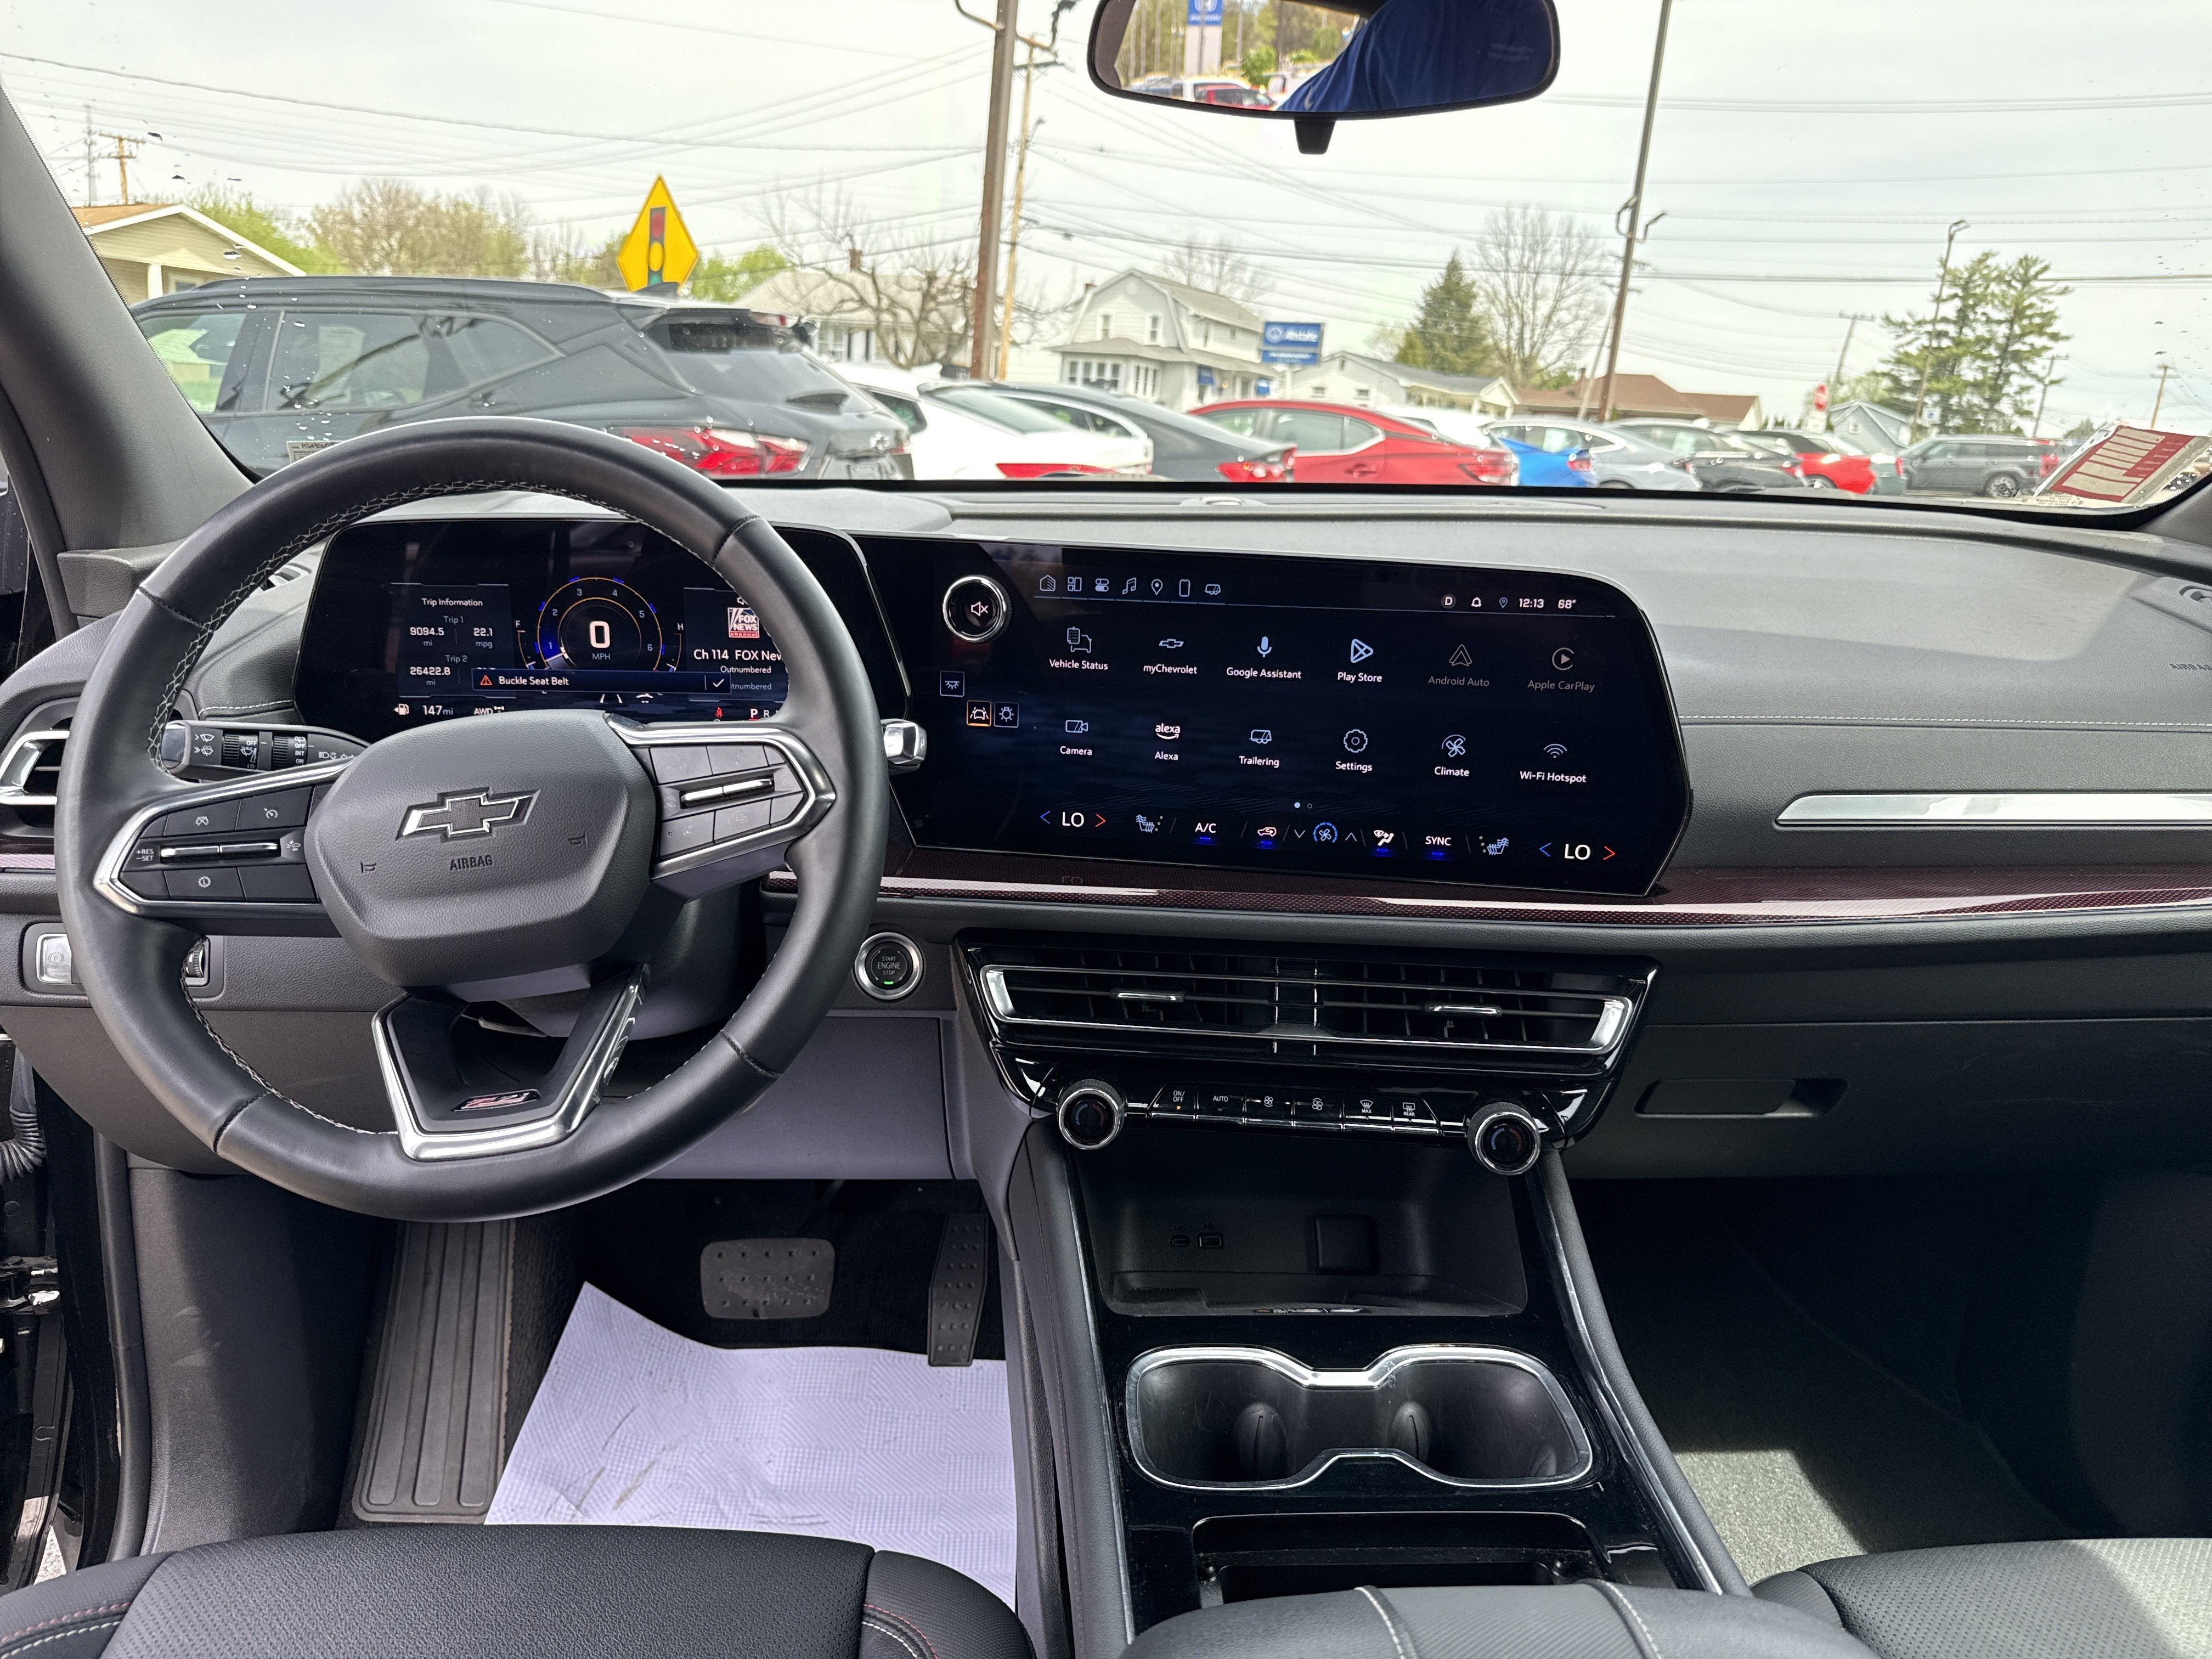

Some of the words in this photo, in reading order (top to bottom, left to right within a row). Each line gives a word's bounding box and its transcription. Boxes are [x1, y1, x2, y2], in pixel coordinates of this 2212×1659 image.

[421, 598, 437, 607] Trip
[439, 598, 483, 606] Information
[1444, 596, 1453, 606] D
[1519, 599, 1544, 608] 12:13
[1558, 599, 1576, 609] 68°
[443, 616, 459, 625] Trip
[738, 615, 757, 623] FOX
[410, 627, 444, 636] 9094.5
[473, 628, 493, 636] 22.1
[590, 620, 611, 648] 0
[445, 654, 461, 663] Trip
[693, 649, 709, 659] Ch
[712, 650, 729, 659] 114
[735, 650, 759, 661] FOX
[720, 665, 771, 674] Outnumbered
[1049, 658, 1079, 669] Vehicle
[1081, 661, 1108, 670] Status
[1143, 664, 1197, 675] myChevrolet
[410, 667, 451, 675] 26422.8
[1227, 667, 1258, 679] Google
[1260, 668, 1302, 680] Assistant
[499, 676, 527, 685] Buckle
[529, 676, 550, 685] Seat
[551, 677, 569, 685] Belt
[1338, 672, 1356, 684] Play
[1358, 673, 1383, 682] Store
[1428, 675, 1465, 686] Android
[1467, 678, 1490, 687] Auto
[1527, 680, 1555, 691] Apple
[1558, 680, 1595, 693] CarPlay
[751, 709, 758, 718] P
[1155, 723, 1181, 733] alexa
[1060, 746, 1092, 757] Camera
[1154, 751, 1178, 761] Alexa
[1239, 756, 1279, 768] Trailering
[1335, 761, 1373, 773] Settings
[1434, 766, 1470, 777] Climate
[1520, 771, 1545, 781] Wi-Fi
[1547, 772, 1587, 784] Hotspot
[1062, 812, 1085, 827] LO
[1195, 823, 1217, 834] A/C
[1425, 836, 1451, 846] SYNC
[1564, 844, 1590, 861] LO
[450, 855, 493, 871] AIRBAG
